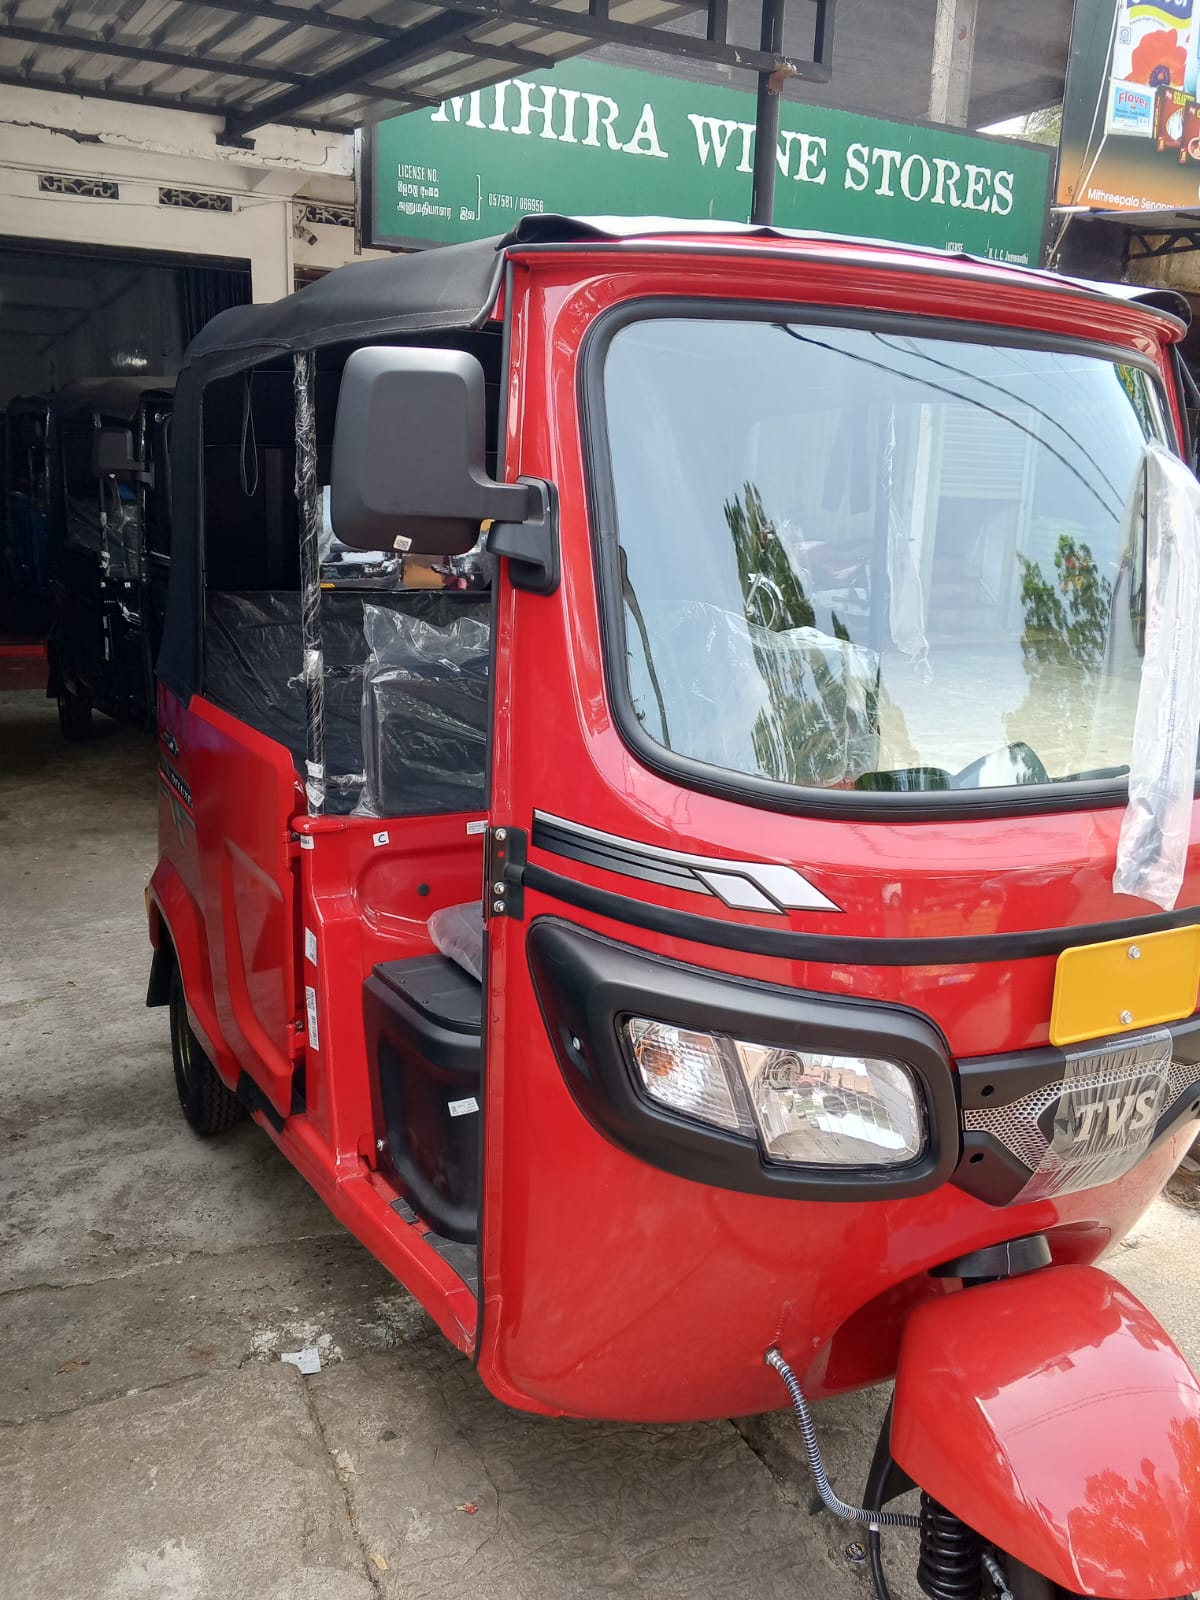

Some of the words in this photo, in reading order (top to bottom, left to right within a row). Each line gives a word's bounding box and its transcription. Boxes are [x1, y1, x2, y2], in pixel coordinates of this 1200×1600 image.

[430, 79, 669, 158] MIHIRA
[844, 142, 1015, 216] STORES
[398, 164, 425, 181] LICENSE
[427, 168, 440, 183] NO.
[1087, 187, 1140, 208] Mithreepala
[378, 834, 387, 843] C
[1073, 1089, 1157, 1143] TVS
